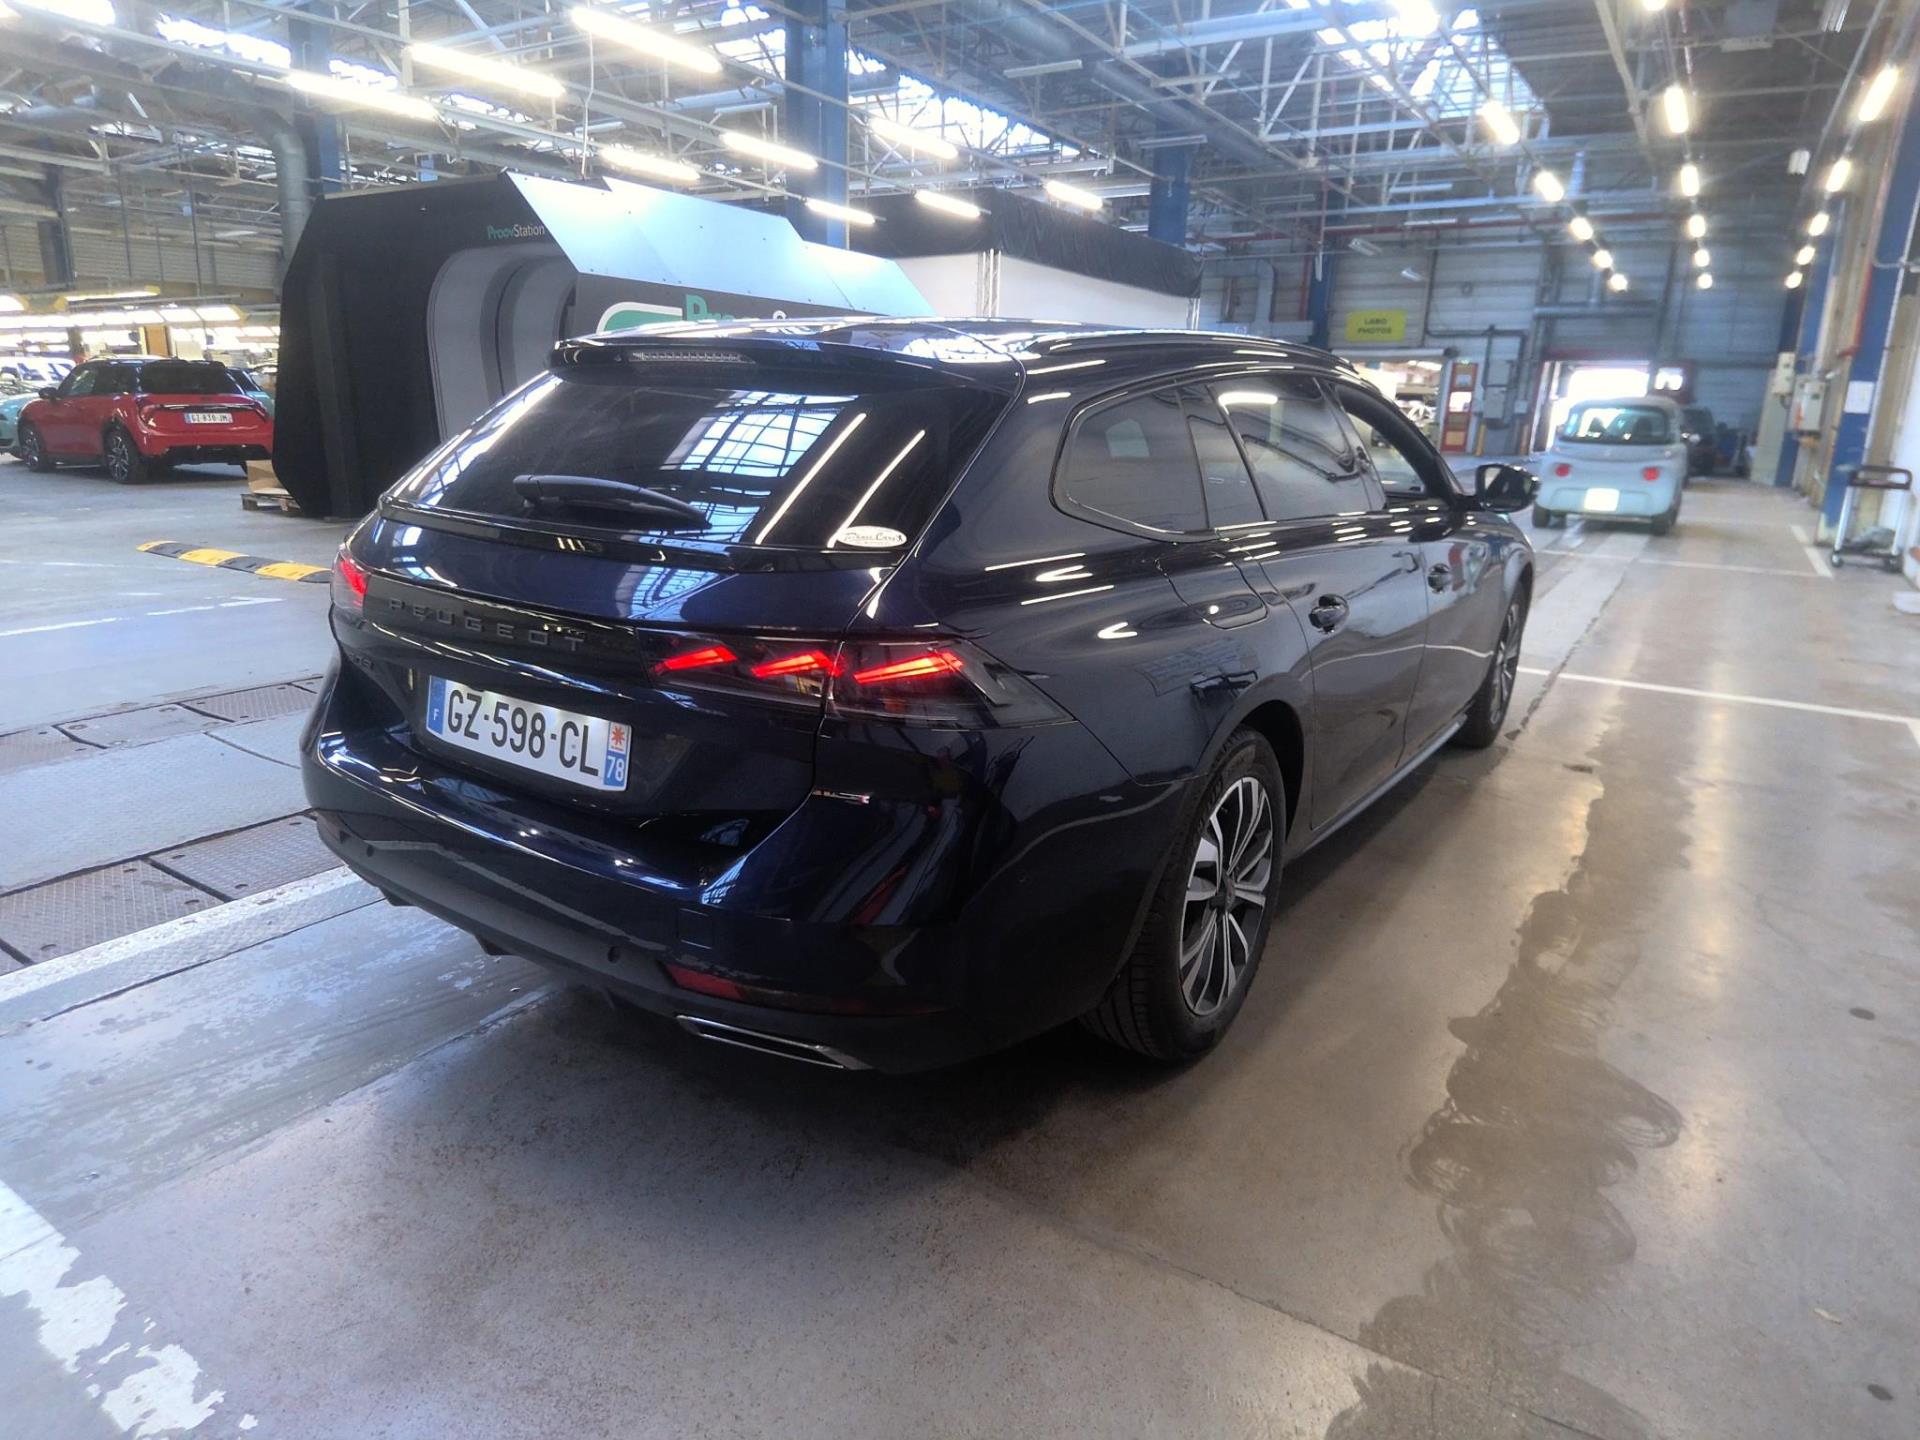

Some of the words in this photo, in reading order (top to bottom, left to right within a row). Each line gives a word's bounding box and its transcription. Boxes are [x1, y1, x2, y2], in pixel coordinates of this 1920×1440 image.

[487, 223, 545, 240] ProovStation
[1364, 318, 1387, 326] LABO
[1357, 327, 1392, 335] PHOTOS
[388, 598, 585, 652] PEUGEOT
[432, 708, 439, 721] F
[446, 689, 600, 777] GZ-598-CL
[606, 755, 626, 782] 78
